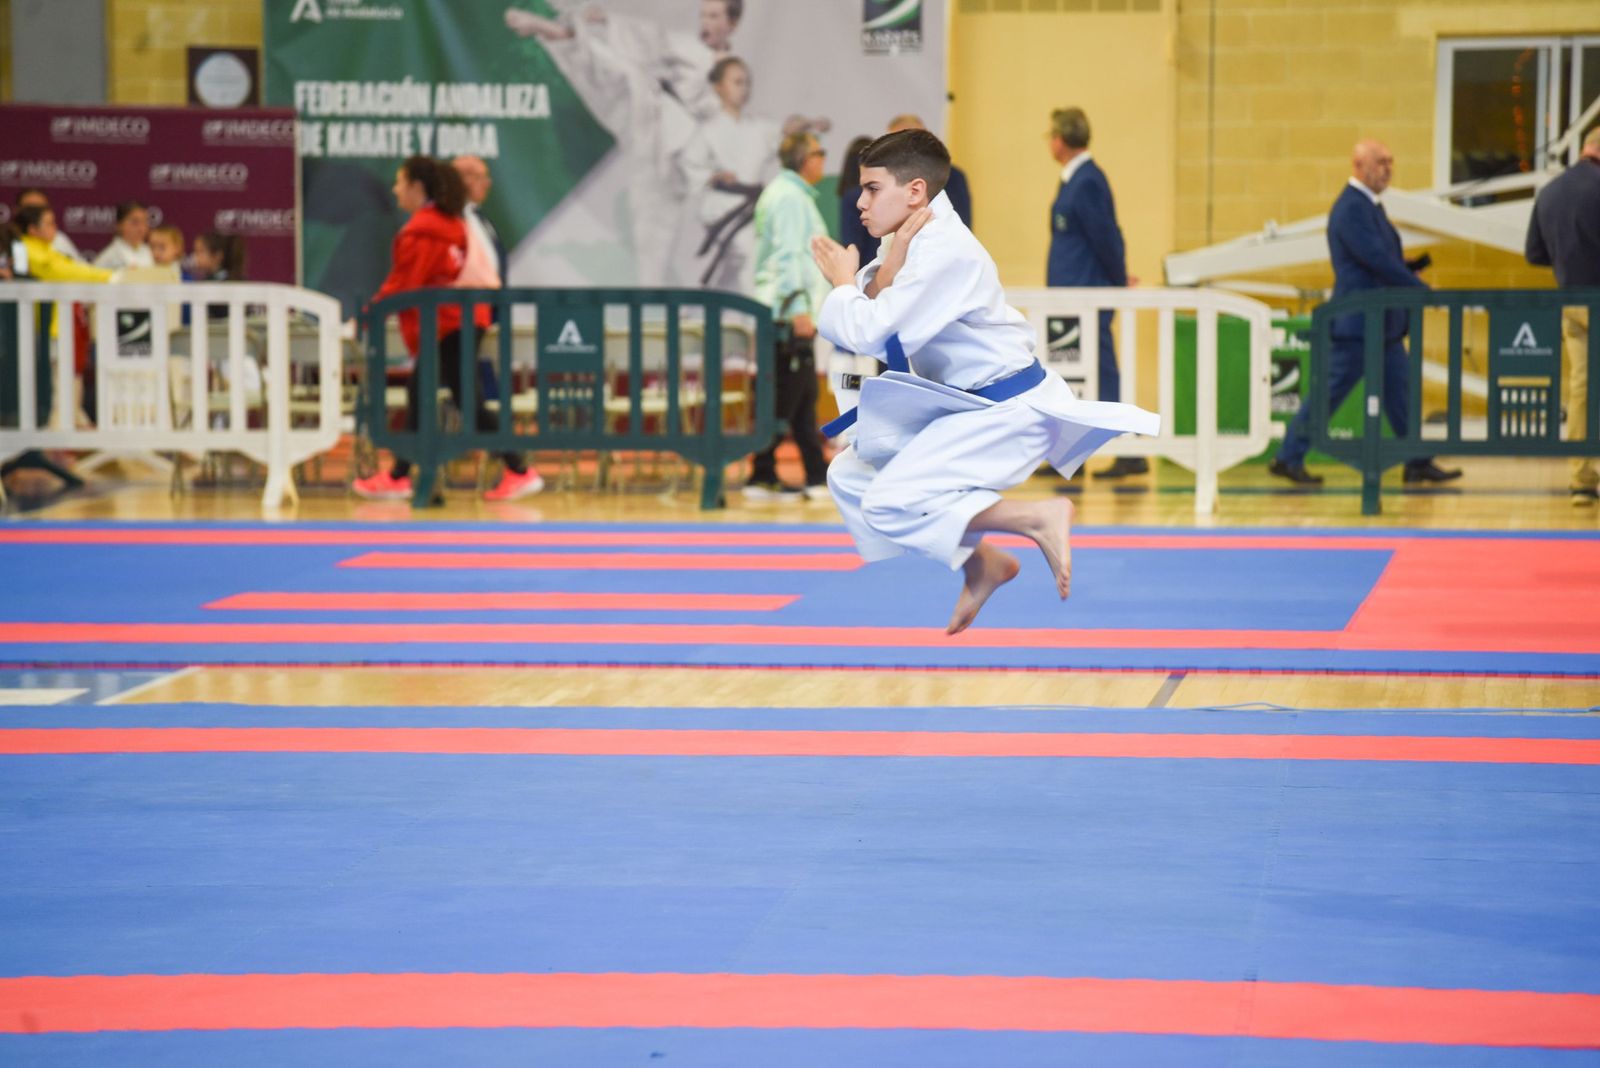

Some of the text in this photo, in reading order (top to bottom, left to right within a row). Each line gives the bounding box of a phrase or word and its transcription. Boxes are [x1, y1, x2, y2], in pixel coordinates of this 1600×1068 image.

[294, 75, 551, 119] FEDERACIÓN ANDALUZA
[327, 121, 415, 157] KARATE
[417, 123, 433, 157] Y
